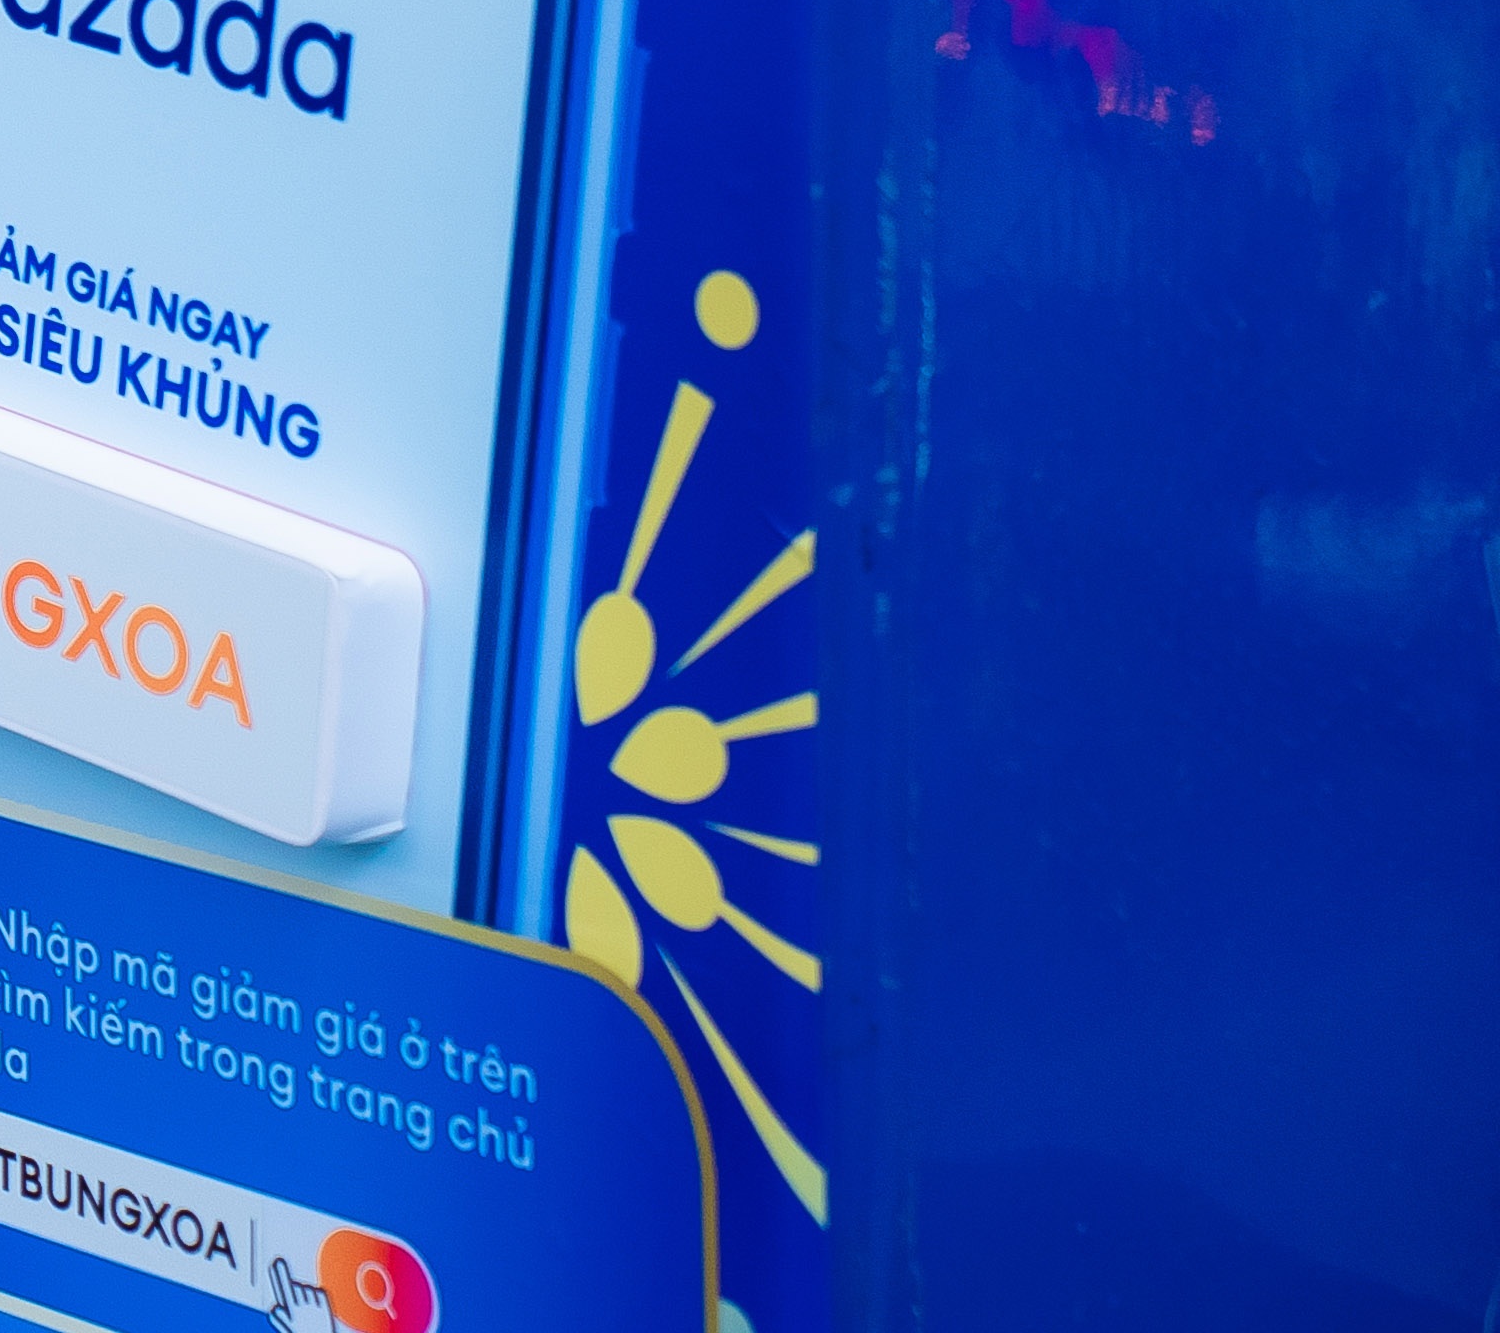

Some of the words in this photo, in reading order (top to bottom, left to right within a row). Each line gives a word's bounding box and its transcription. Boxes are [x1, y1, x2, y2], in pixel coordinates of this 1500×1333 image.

[66, 267, 138, 321] GIÁ
[148, 285, 270, 360] NGAY
[116, 356, 321, 459] KHỦNG
[64, 985, 165, 1061] kiếm
[175, 1025, 297, 1111] trong
[307, 1063, 435, 1152] trang
[447, 1106, 536, 1171] chủ
[112, 950, 178, 999] mã
[191, 965, 302, 1034] giảm
[314, 999, 387, 1059] giá
[439, 1036, 538, 1104] trên
